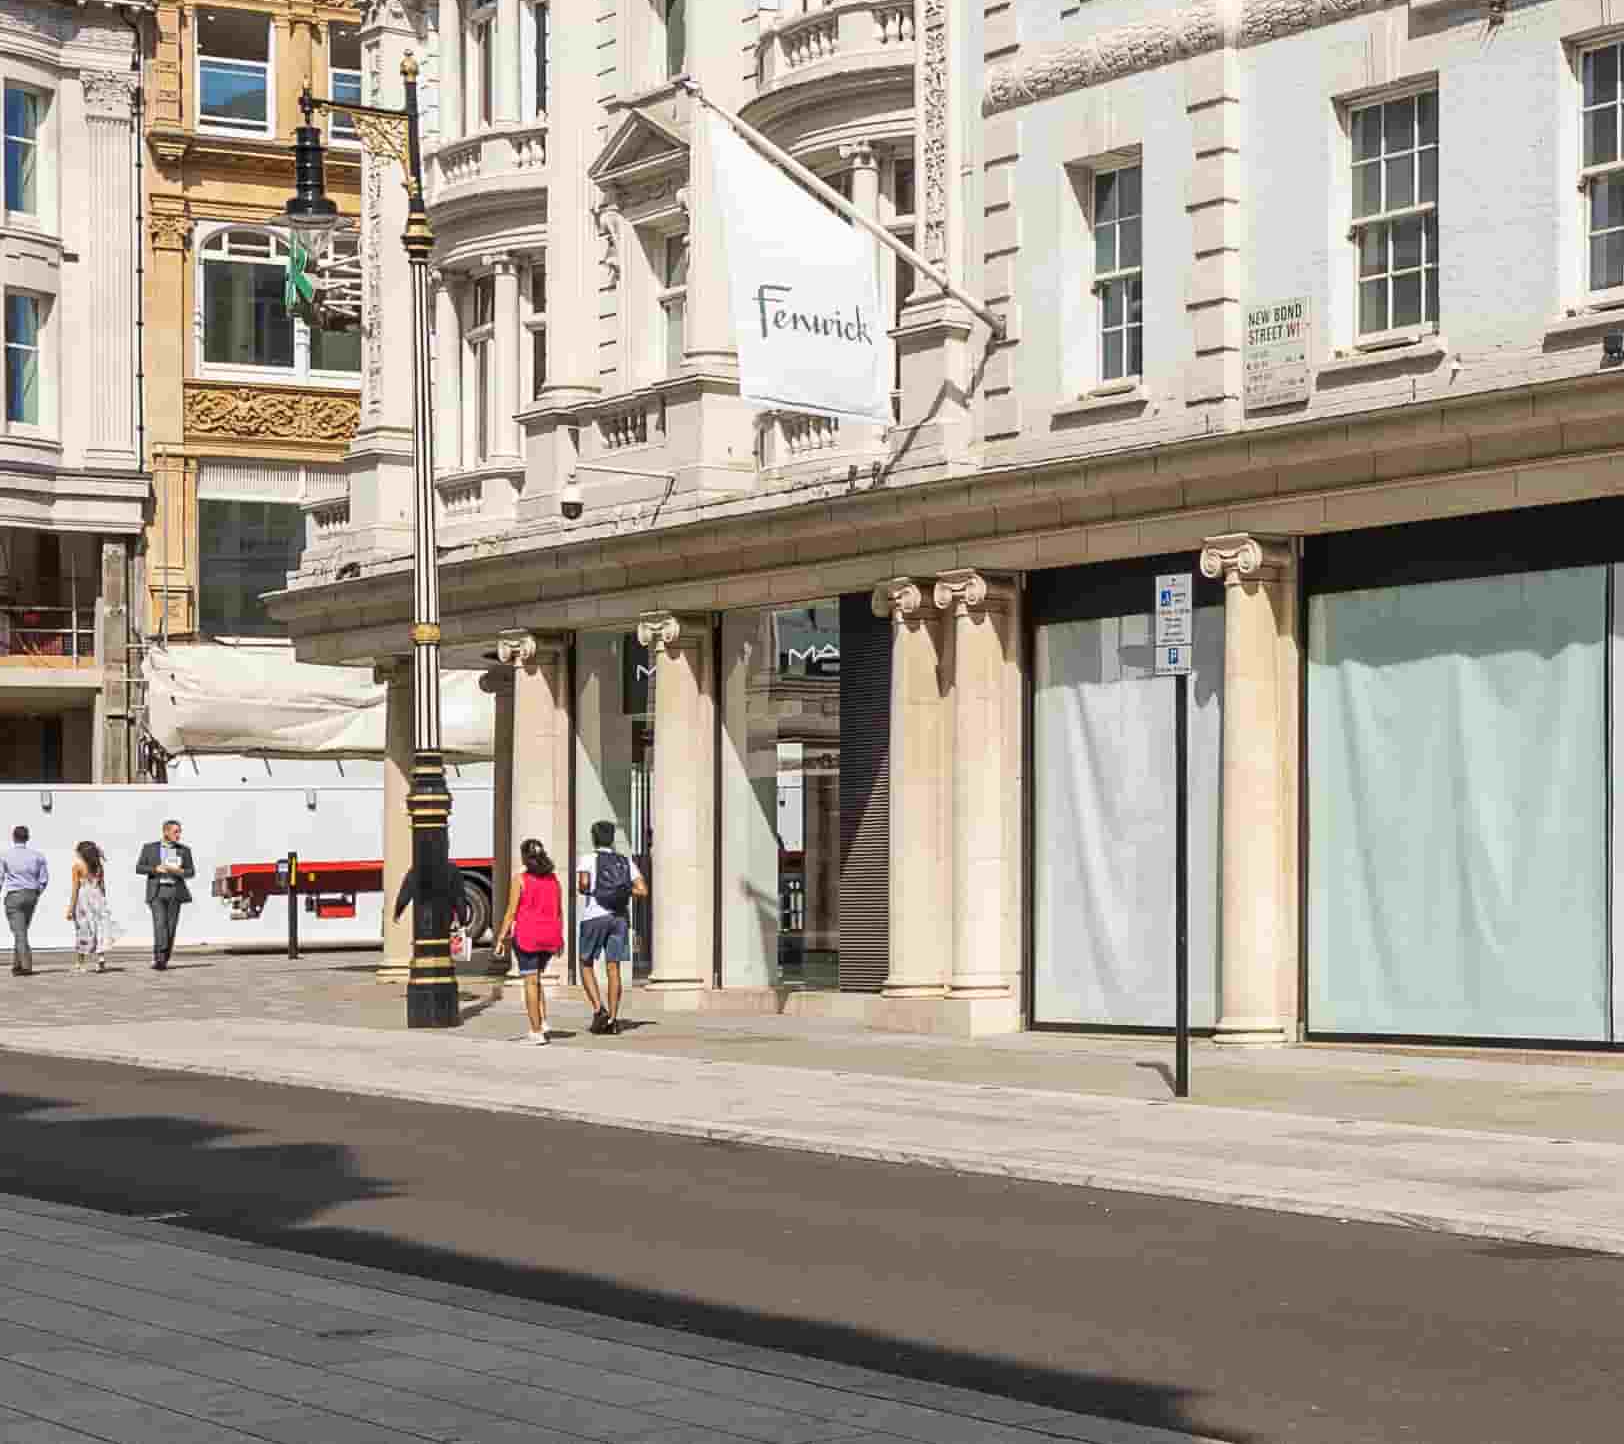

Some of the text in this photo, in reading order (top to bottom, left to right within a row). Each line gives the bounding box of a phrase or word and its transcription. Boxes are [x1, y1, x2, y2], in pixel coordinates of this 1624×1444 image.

[752, 283, 873, 346] Fenwick
[1248, 303, 1303, 328] NEW BOND
[1248, 324, 1283, 345] STREET
